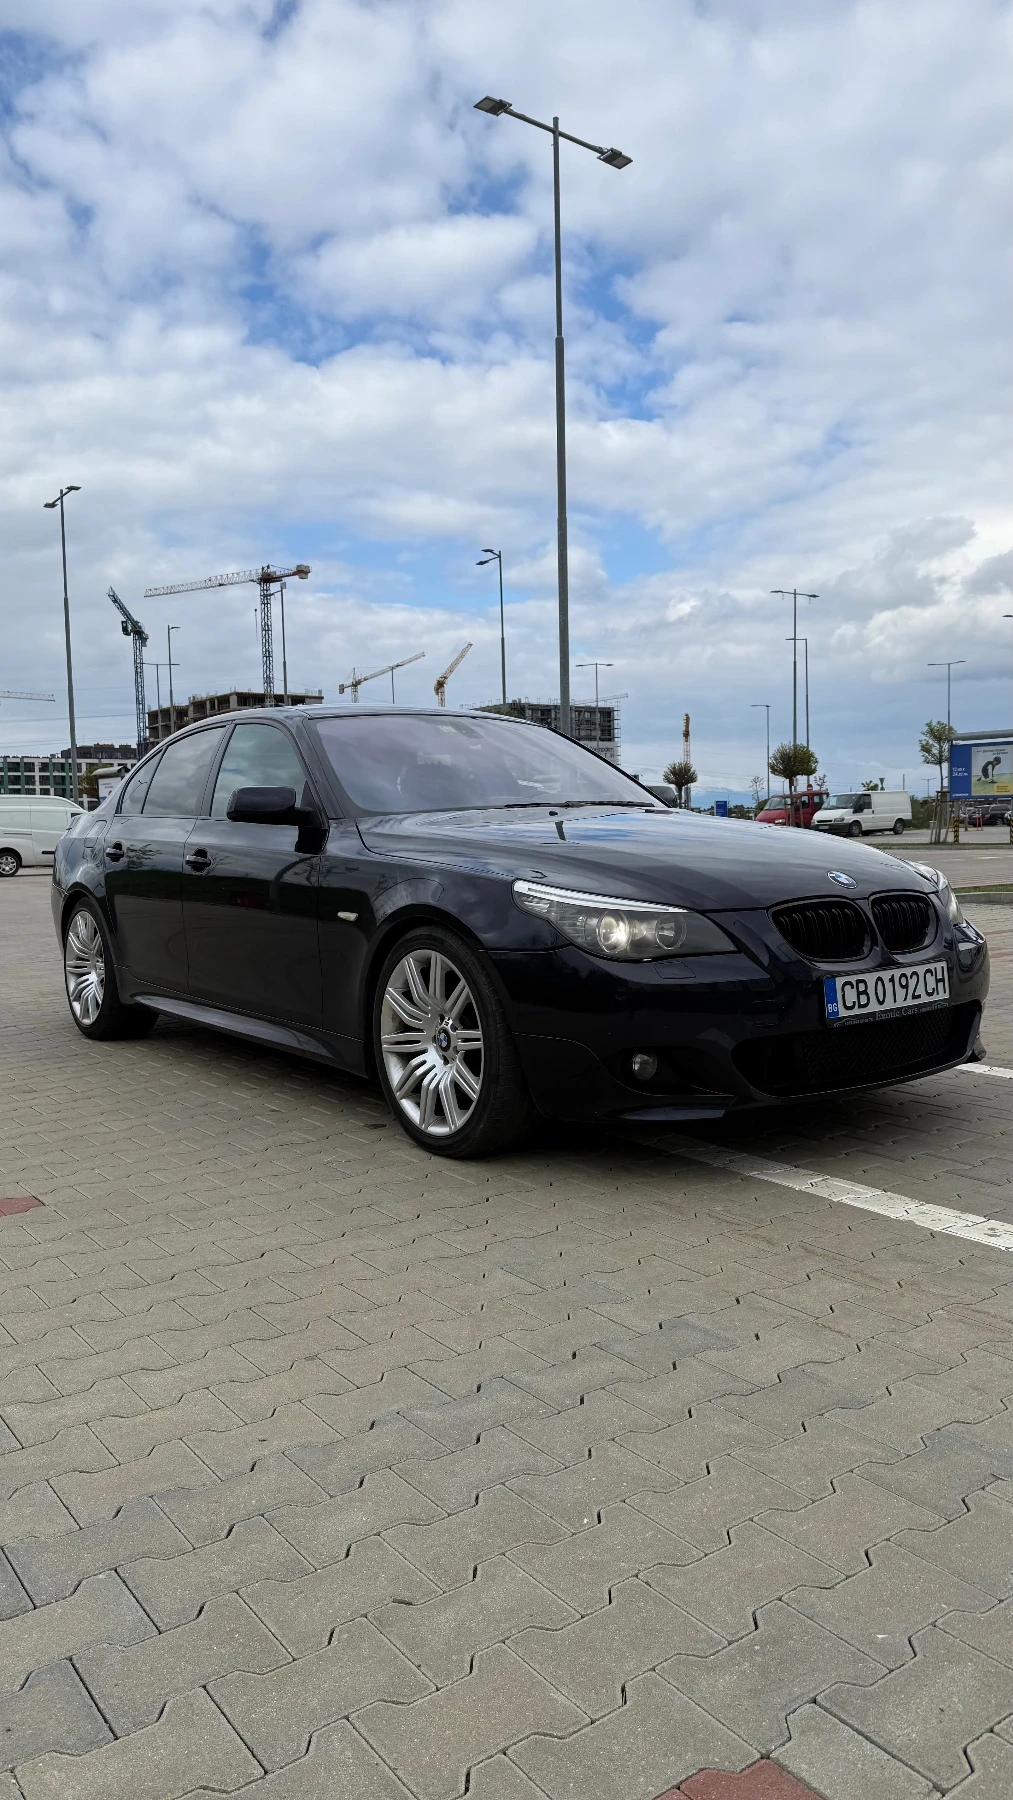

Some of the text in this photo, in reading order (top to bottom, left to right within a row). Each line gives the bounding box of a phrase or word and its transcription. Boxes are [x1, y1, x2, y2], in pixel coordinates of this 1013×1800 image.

[841, 966, 946, 1010] CB 0192 CH
[828, 1003, 838, 1012] BG
[875, 1010, 900, 1021] Exotic
[901, 1007, 918, 1016] Cars
